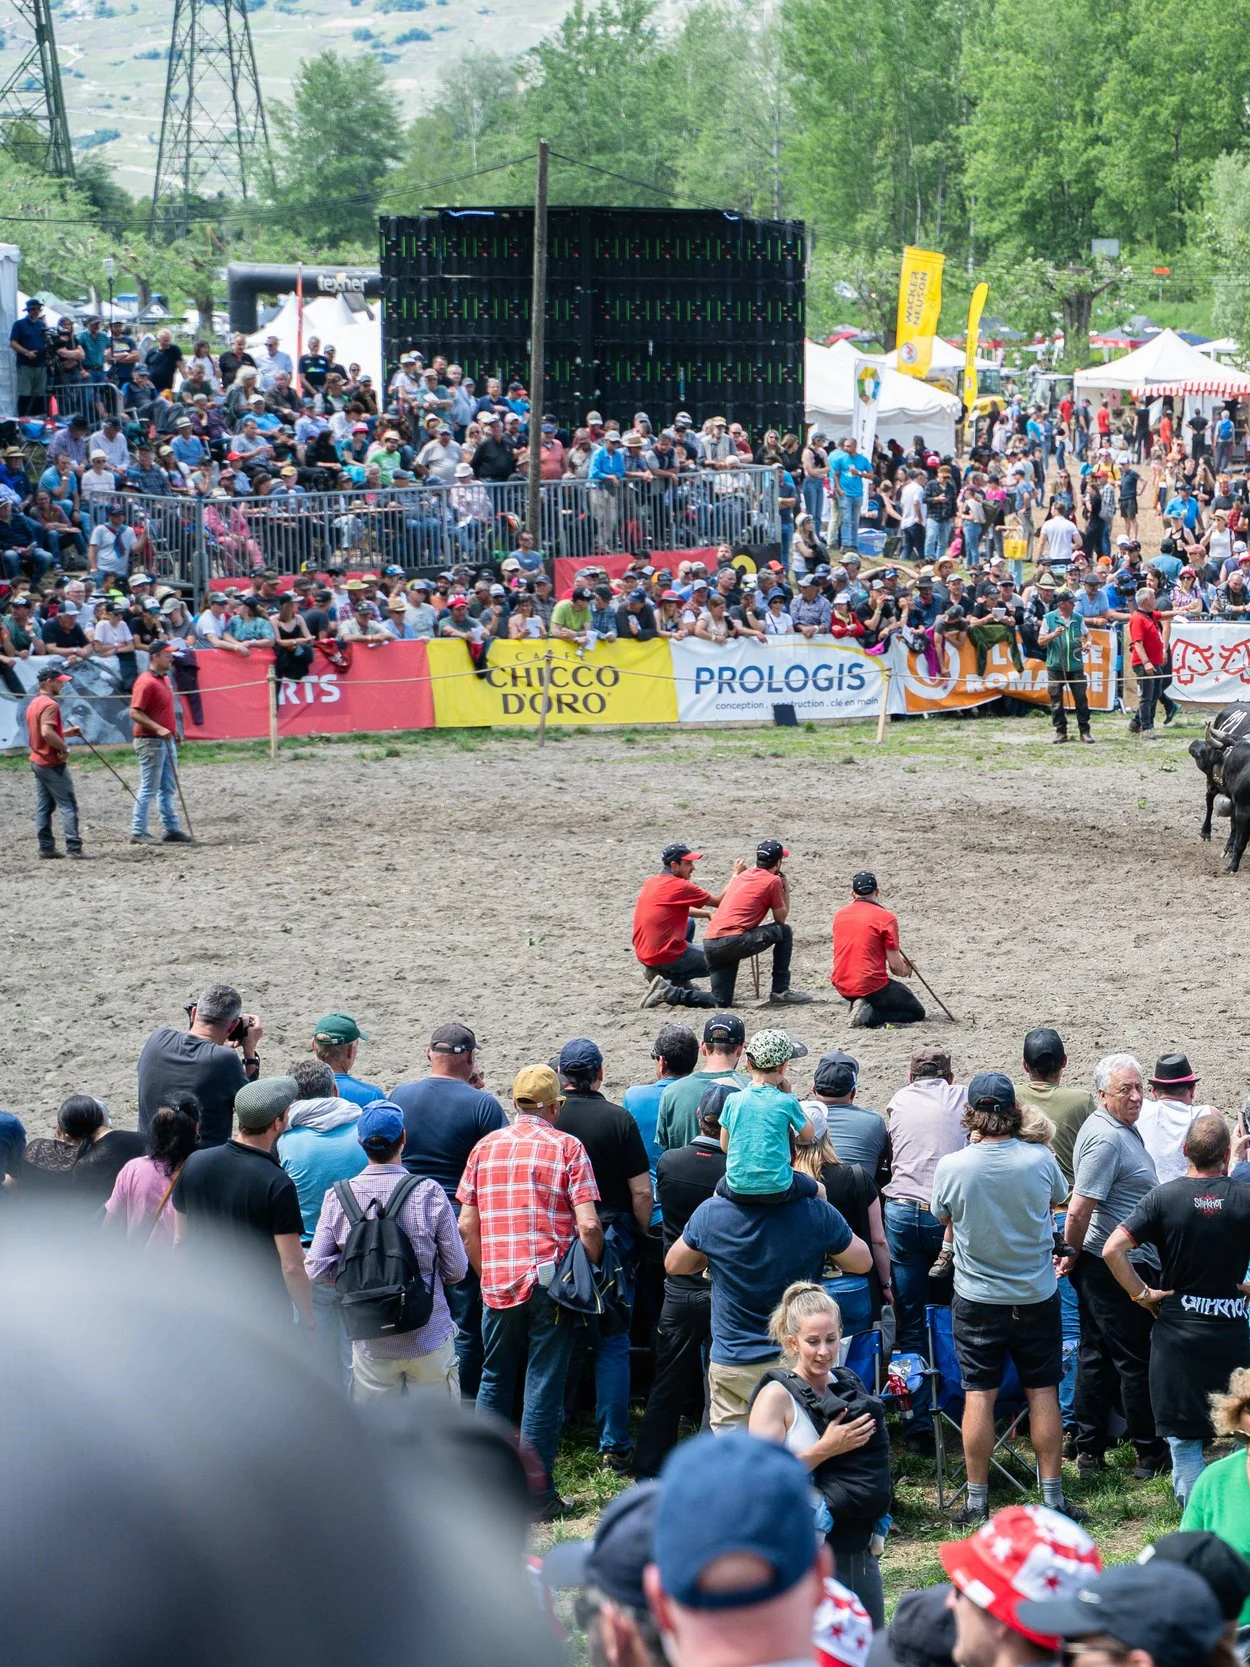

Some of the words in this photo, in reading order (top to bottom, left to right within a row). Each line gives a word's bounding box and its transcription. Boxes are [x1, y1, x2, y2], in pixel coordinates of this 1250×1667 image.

[317, 272, 368, 293] texner
[905, 271, 919, 324] WACKER
[913, 271, 928, 326] NEUSON
[486, 666, 620, 688] CHICCO
[695, 662, 866, 695] PROLOGIS
[502, 692, 607, 715] D'ORO
[715, 700, 765, 711] conception
[845, 699, 856, 707] en
[858, 696, 879, 706] main
